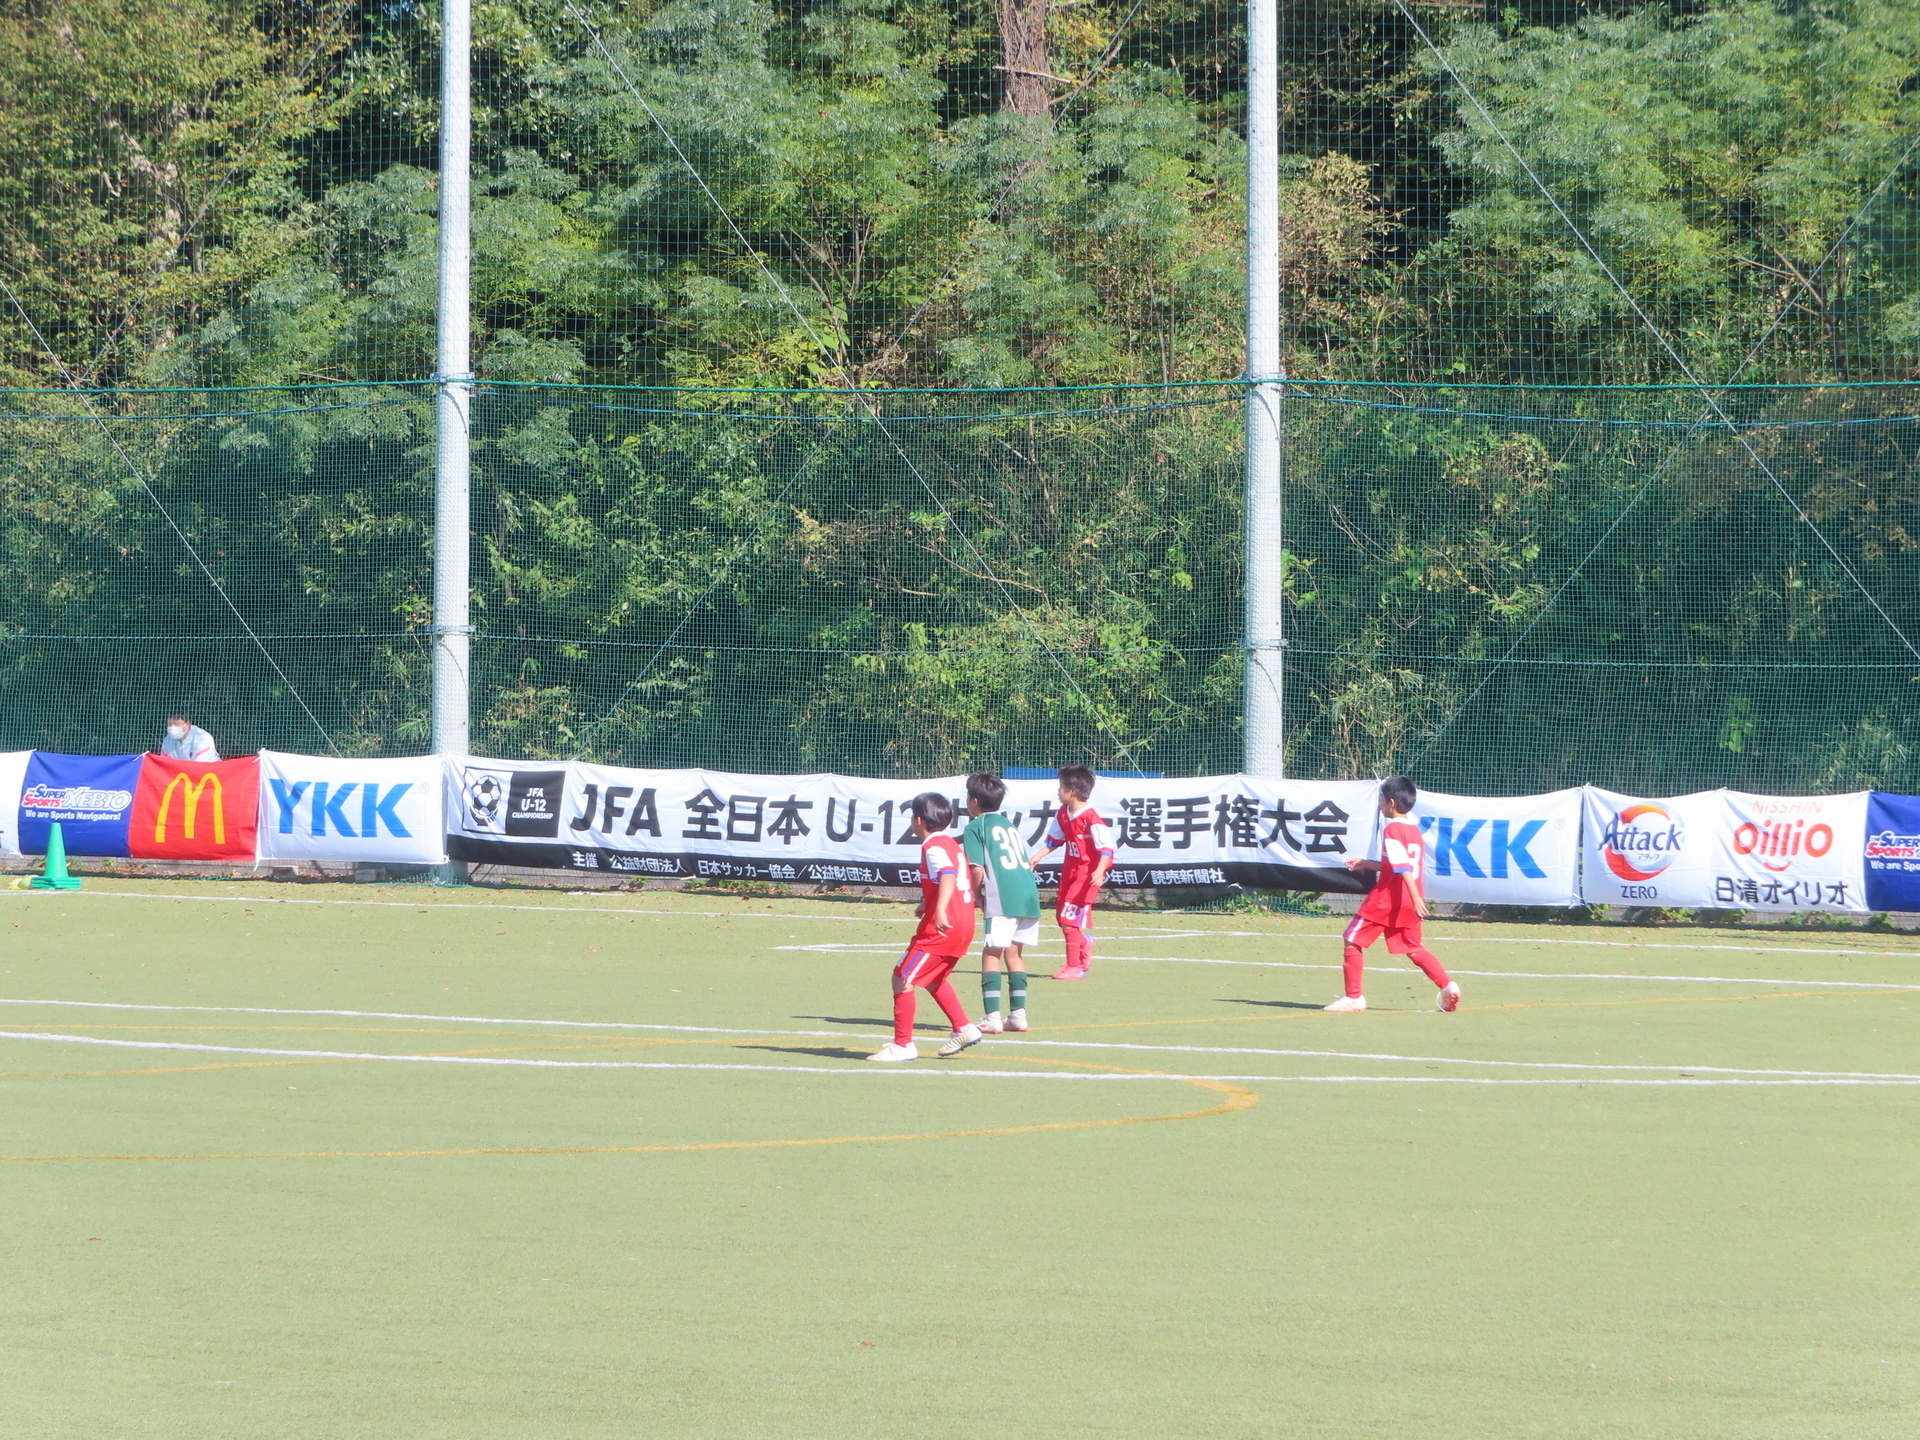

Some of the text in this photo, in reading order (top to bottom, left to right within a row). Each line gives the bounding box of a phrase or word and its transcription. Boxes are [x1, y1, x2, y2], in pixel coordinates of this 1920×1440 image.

[36, 784, 66, 798] SUPER
[526, 787, 544, 798] JFA
[22, 794, 61, 807] SPORTS
[62, 787, 132, 812] XEBIO
[521, 798, 547, 812] U-12
[269, 778, 413, 838] YKK
[570, 783, 662, 838] JFA
[1752, 800, 1824, 814] NISSHIN
[25, 809, 121, 821] We are Sports Navigators!
[511, 811, 554, 820] CHAMPIONSHIP
[1598, 812, 1684, 851] Attack
[992, 825, 1030, 870] 30
[1865, 842, 1915, 857] SPORTS
[572, 851, 599, 868] 主催
[609, 854, 688, 874] 公益財団法人
[1870, 860, 1885, 870] We
[1886, 862, 1902, 870] are
[1620, 885, 1658, 899] ZERO
[1715, 876, 1849, 906] 日清オイリオ
